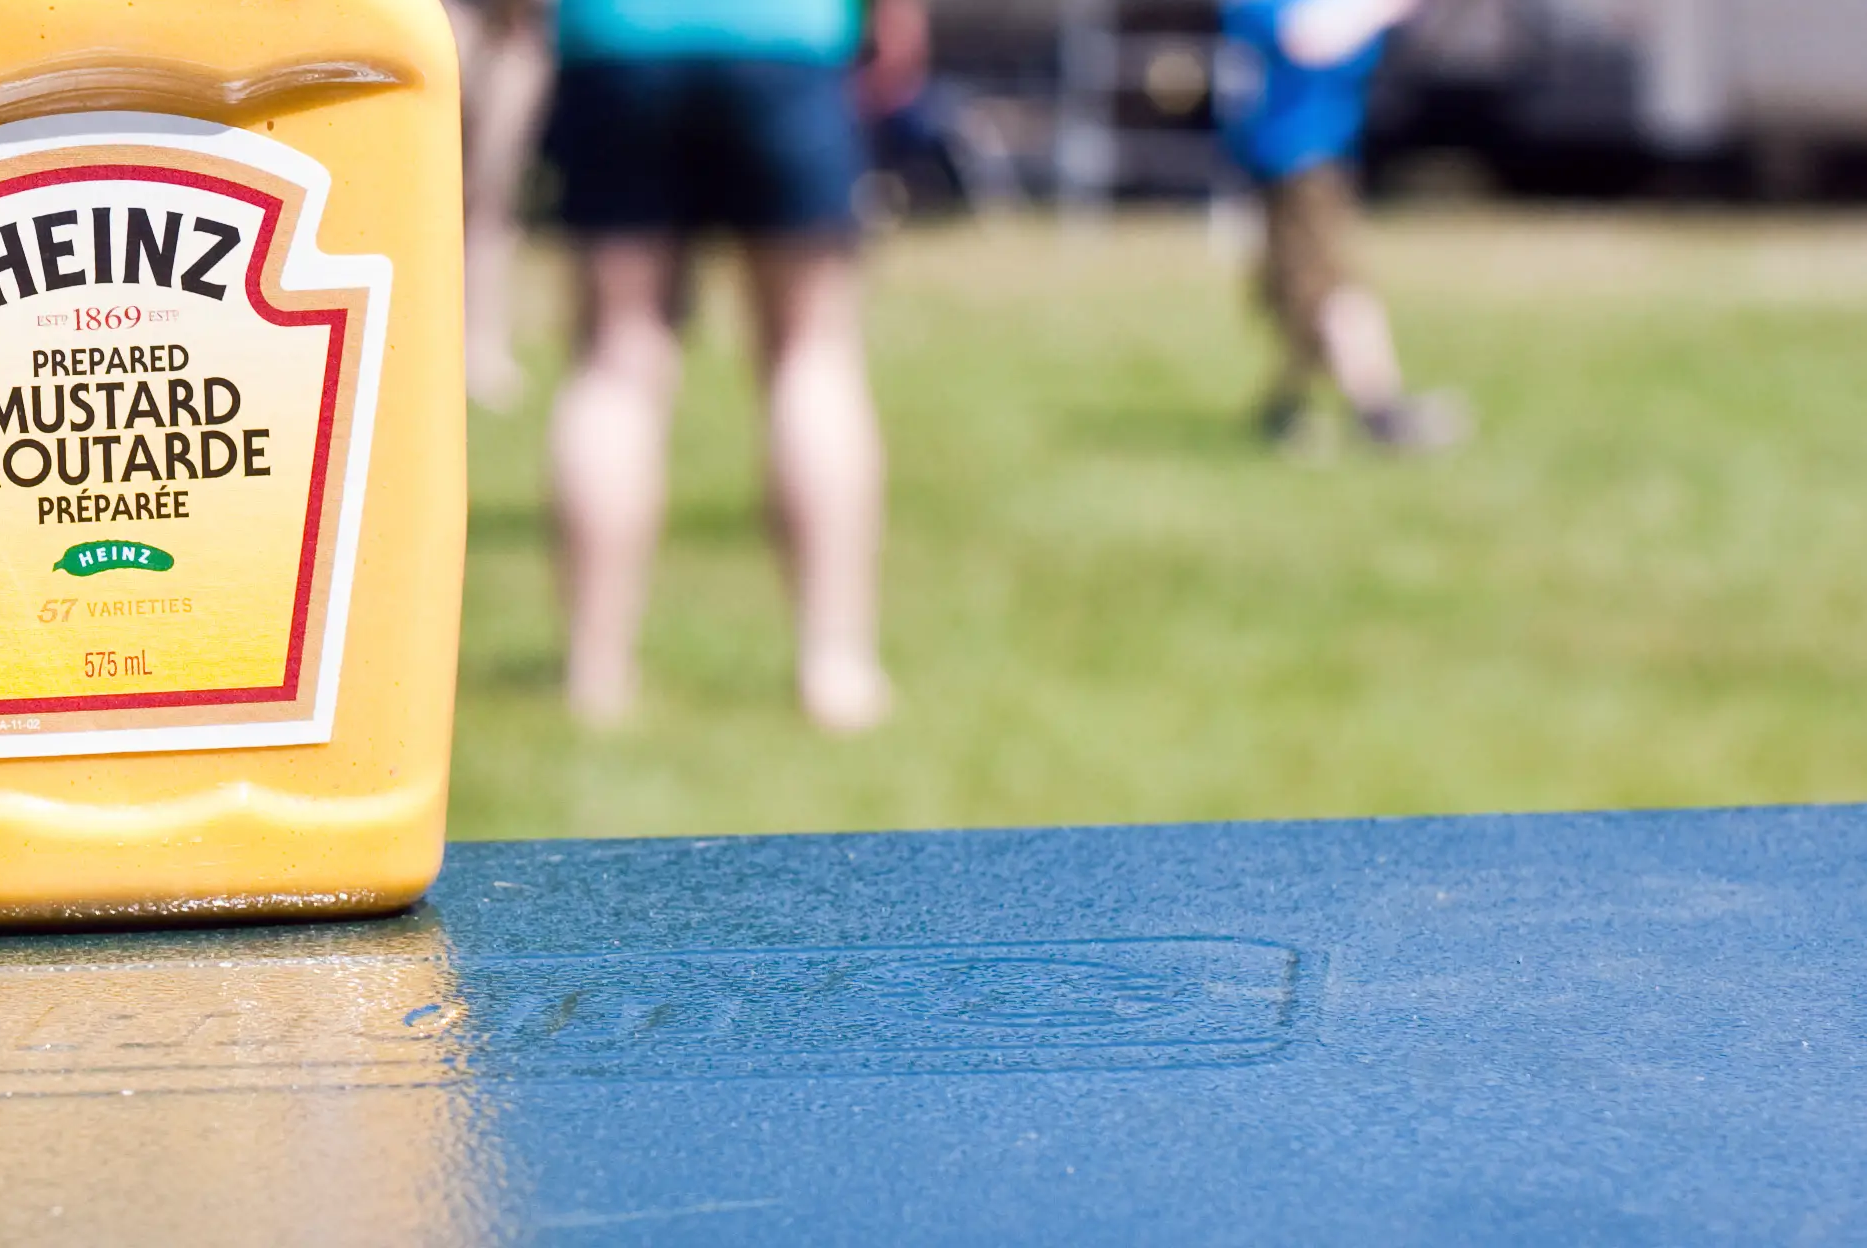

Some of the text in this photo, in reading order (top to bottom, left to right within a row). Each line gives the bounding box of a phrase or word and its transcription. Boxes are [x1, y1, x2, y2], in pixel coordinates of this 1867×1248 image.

[74, 306, 141, 330] 1869
[33, 344, 189, 378] PREPARED
[38, 485, 189, 524] PRÉPARÉE
[78, 546, 151, 567] HEINZ
[37, 598, 193, 623] 57 VARIETIES
[85, 650, 152, 678] 575 mL
